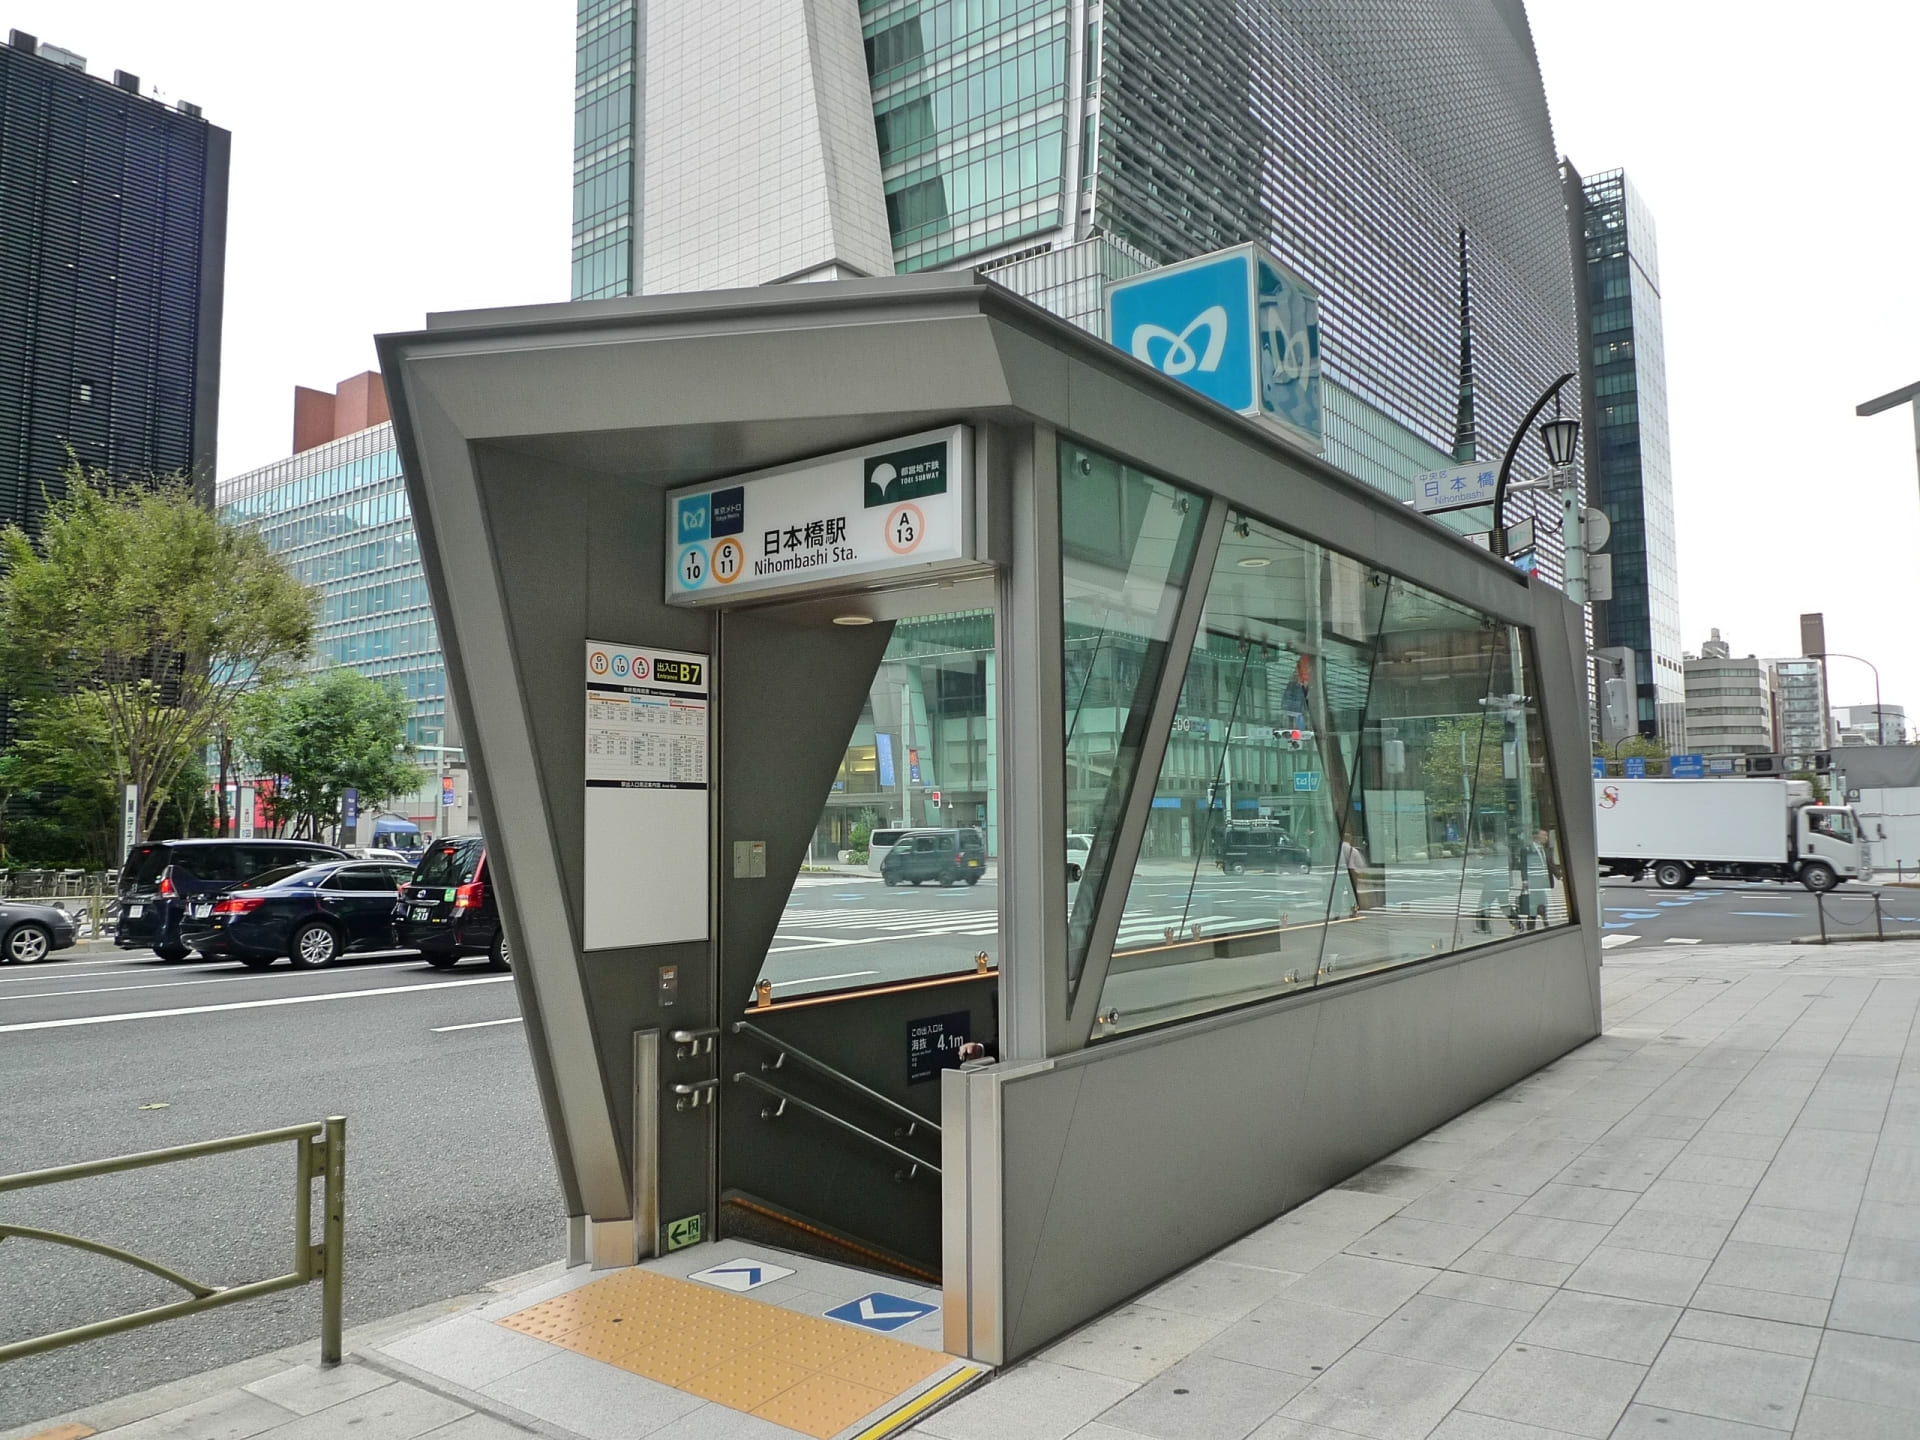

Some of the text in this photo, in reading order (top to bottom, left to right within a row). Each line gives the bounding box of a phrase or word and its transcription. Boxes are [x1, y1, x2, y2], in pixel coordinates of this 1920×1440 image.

[901, 461, 939, 476] 都営地下鉄
[1419, 470, 1448, 480] 中央区
[901, 471, 939, 485] TOEI SUBWAY
[1424, 470, 1495, 497] 日本橋
[1434, 490, 1484, 504] Nihonbashi
[900, 512, 909, 526] A
[764, 517, 846, 556] 日本橋駅
[897, 527, 913, 543] 13
[689, 552, 697, 564] T
[723, 545, 732, 558] G
[721, 560, 733, 573] 11
[754, 546, 858, 576] Nihombashi Sta.
[686, 565, 701, 579] 10
[595, 662, 603, 670] 11
[657, 663, 700, 683] 出入口 B7
[911, 1024, 943, 1037] この出入口は
[937, 1034, 964, 1051] 4.1m
